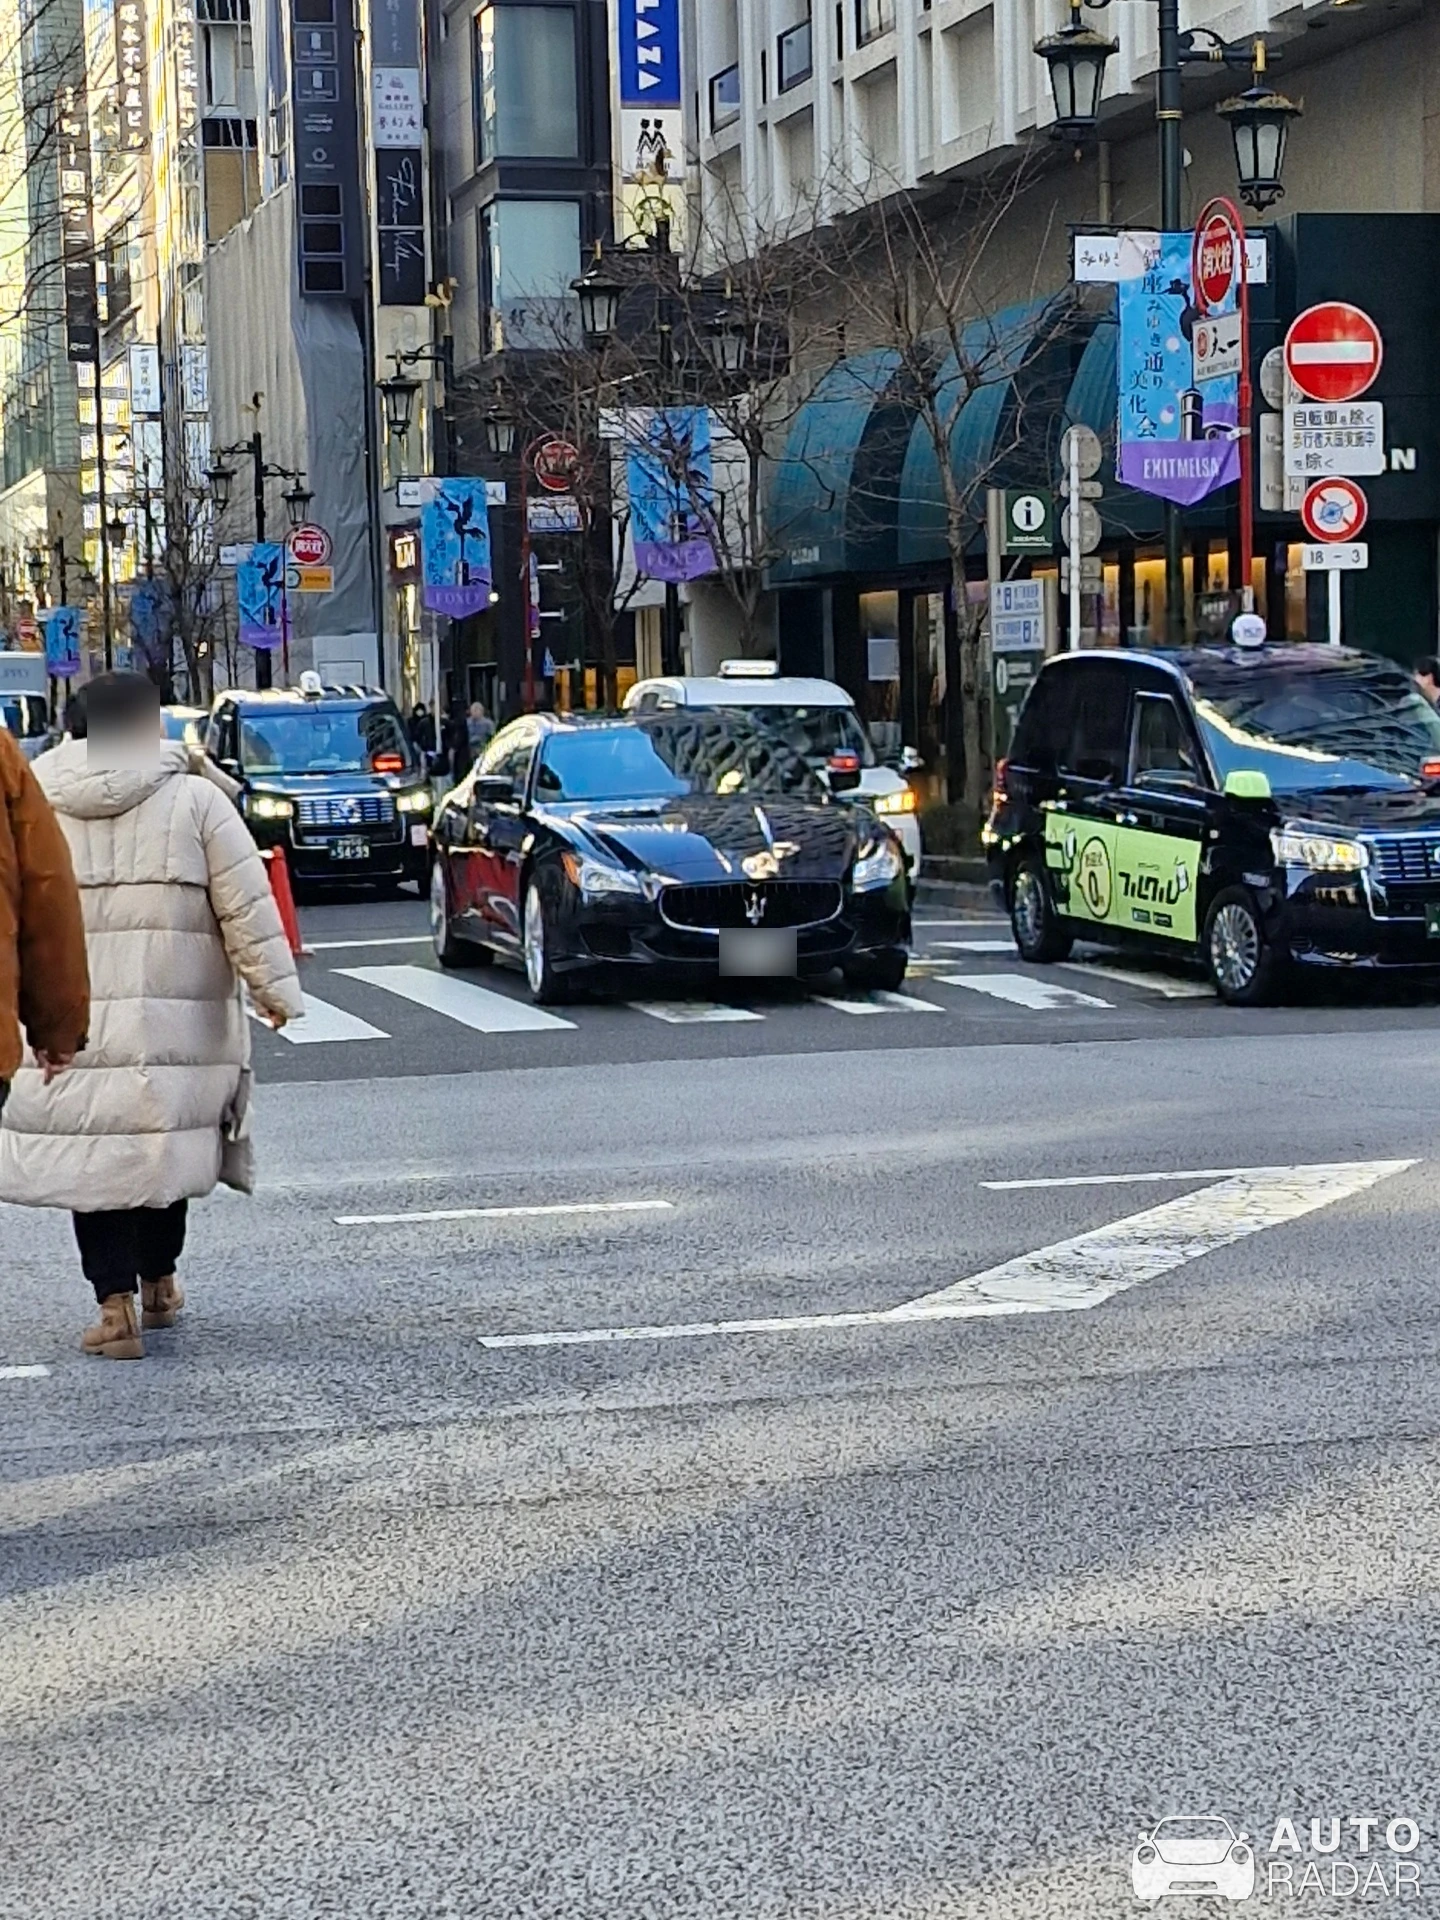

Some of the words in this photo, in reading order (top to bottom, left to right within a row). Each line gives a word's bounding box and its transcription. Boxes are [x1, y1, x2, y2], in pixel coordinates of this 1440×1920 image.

[1293, 408, 1375, 427] 自転車を除く
[1143, 456, 1219, 479] EXITMELSA
